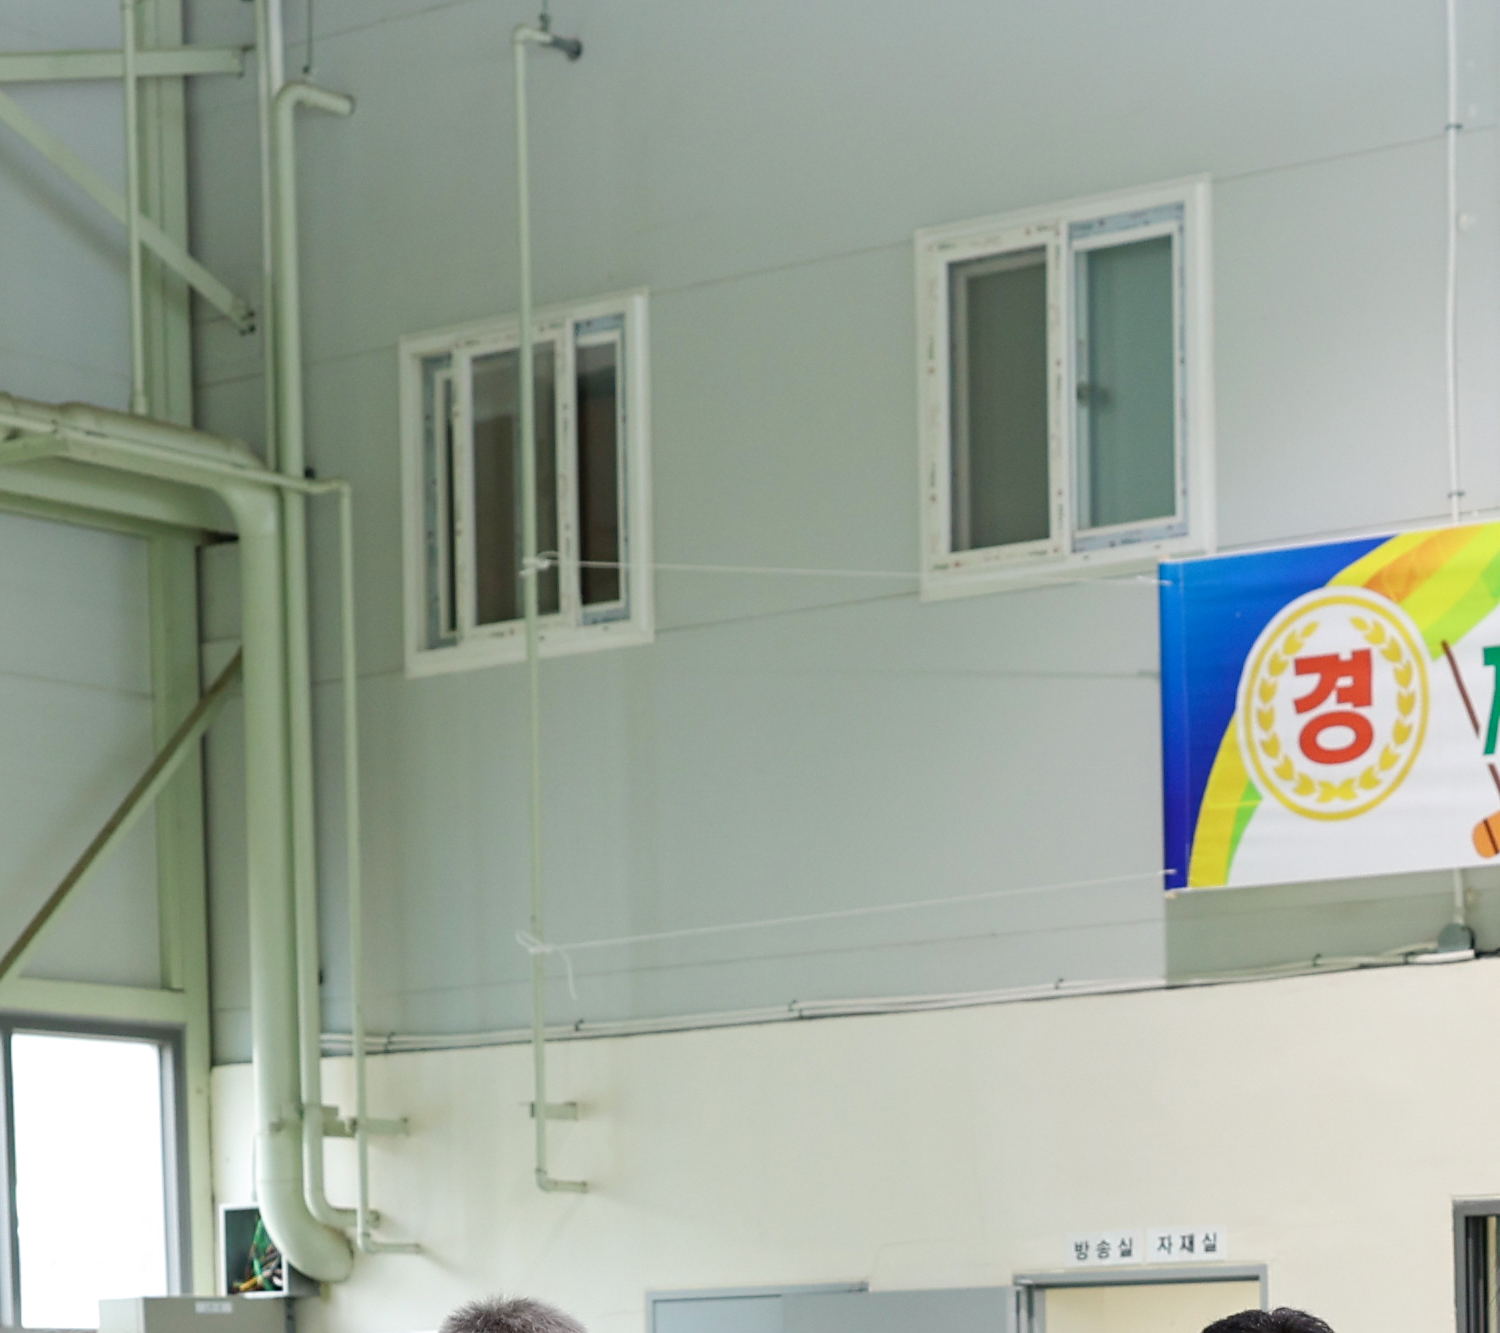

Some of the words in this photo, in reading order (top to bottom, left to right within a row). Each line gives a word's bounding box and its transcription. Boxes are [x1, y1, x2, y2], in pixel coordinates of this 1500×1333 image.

[1291, 649, 1377, 767] 경
[1073, 1237, 1134, 1261] 방송실
[1157, 1231, 1218, 1255] 자재실
